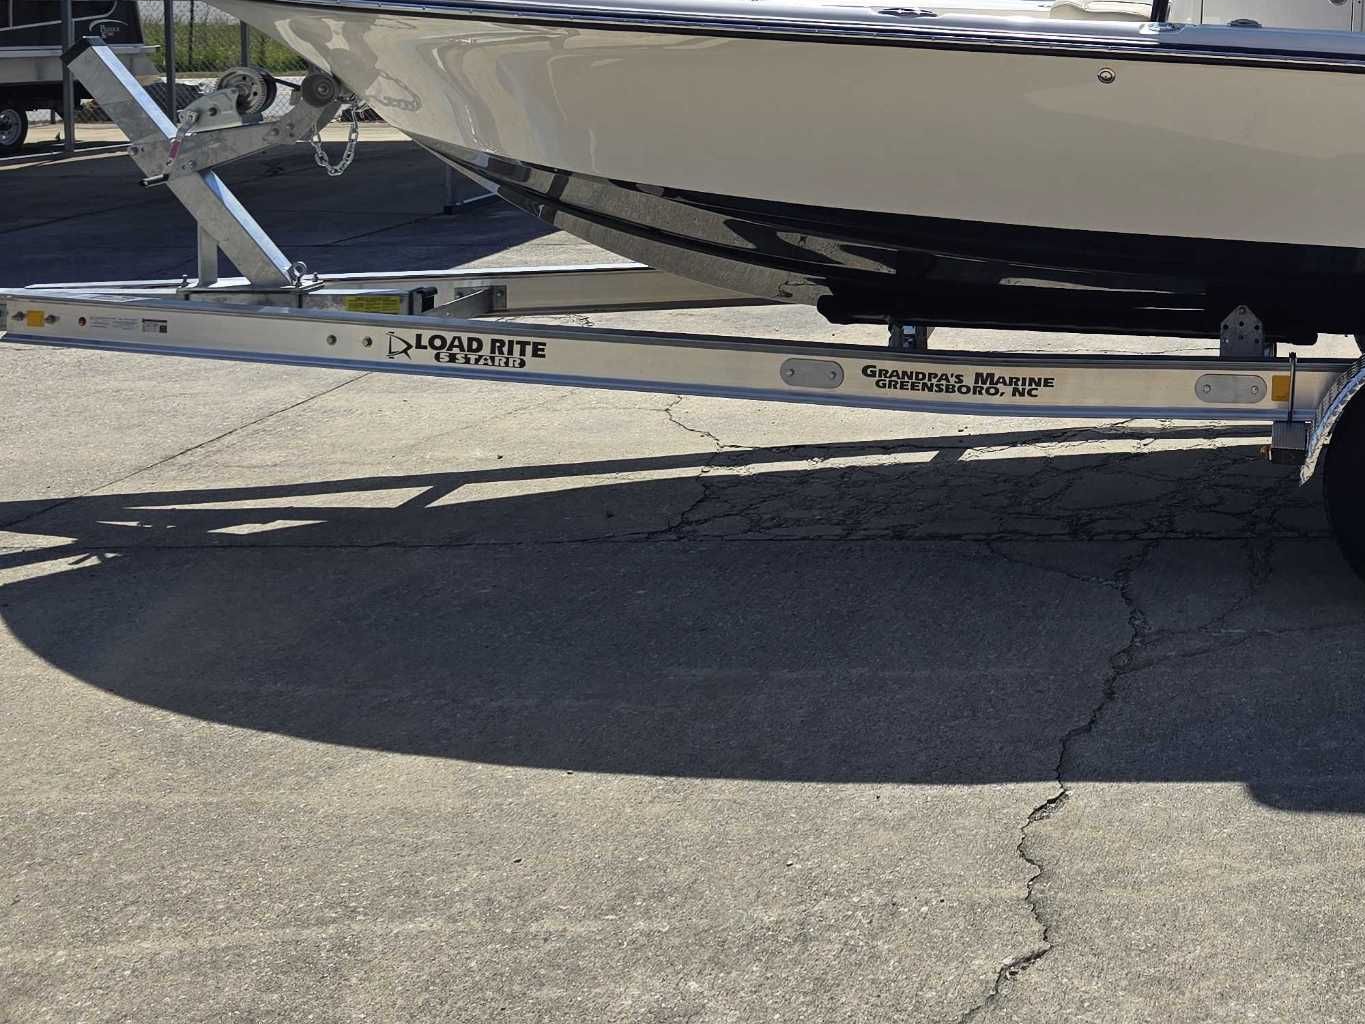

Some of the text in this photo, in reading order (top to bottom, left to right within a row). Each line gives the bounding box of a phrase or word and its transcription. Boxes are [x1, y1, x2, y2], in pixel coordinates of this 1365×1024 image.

[415, 333, 547, 359] LOAD RITE
[439, 352, 522, 368] 5 STARR
[875, 379, 1039, 398] GREENSBORO, NC
[974, 372, 1055, 388] MARINE
